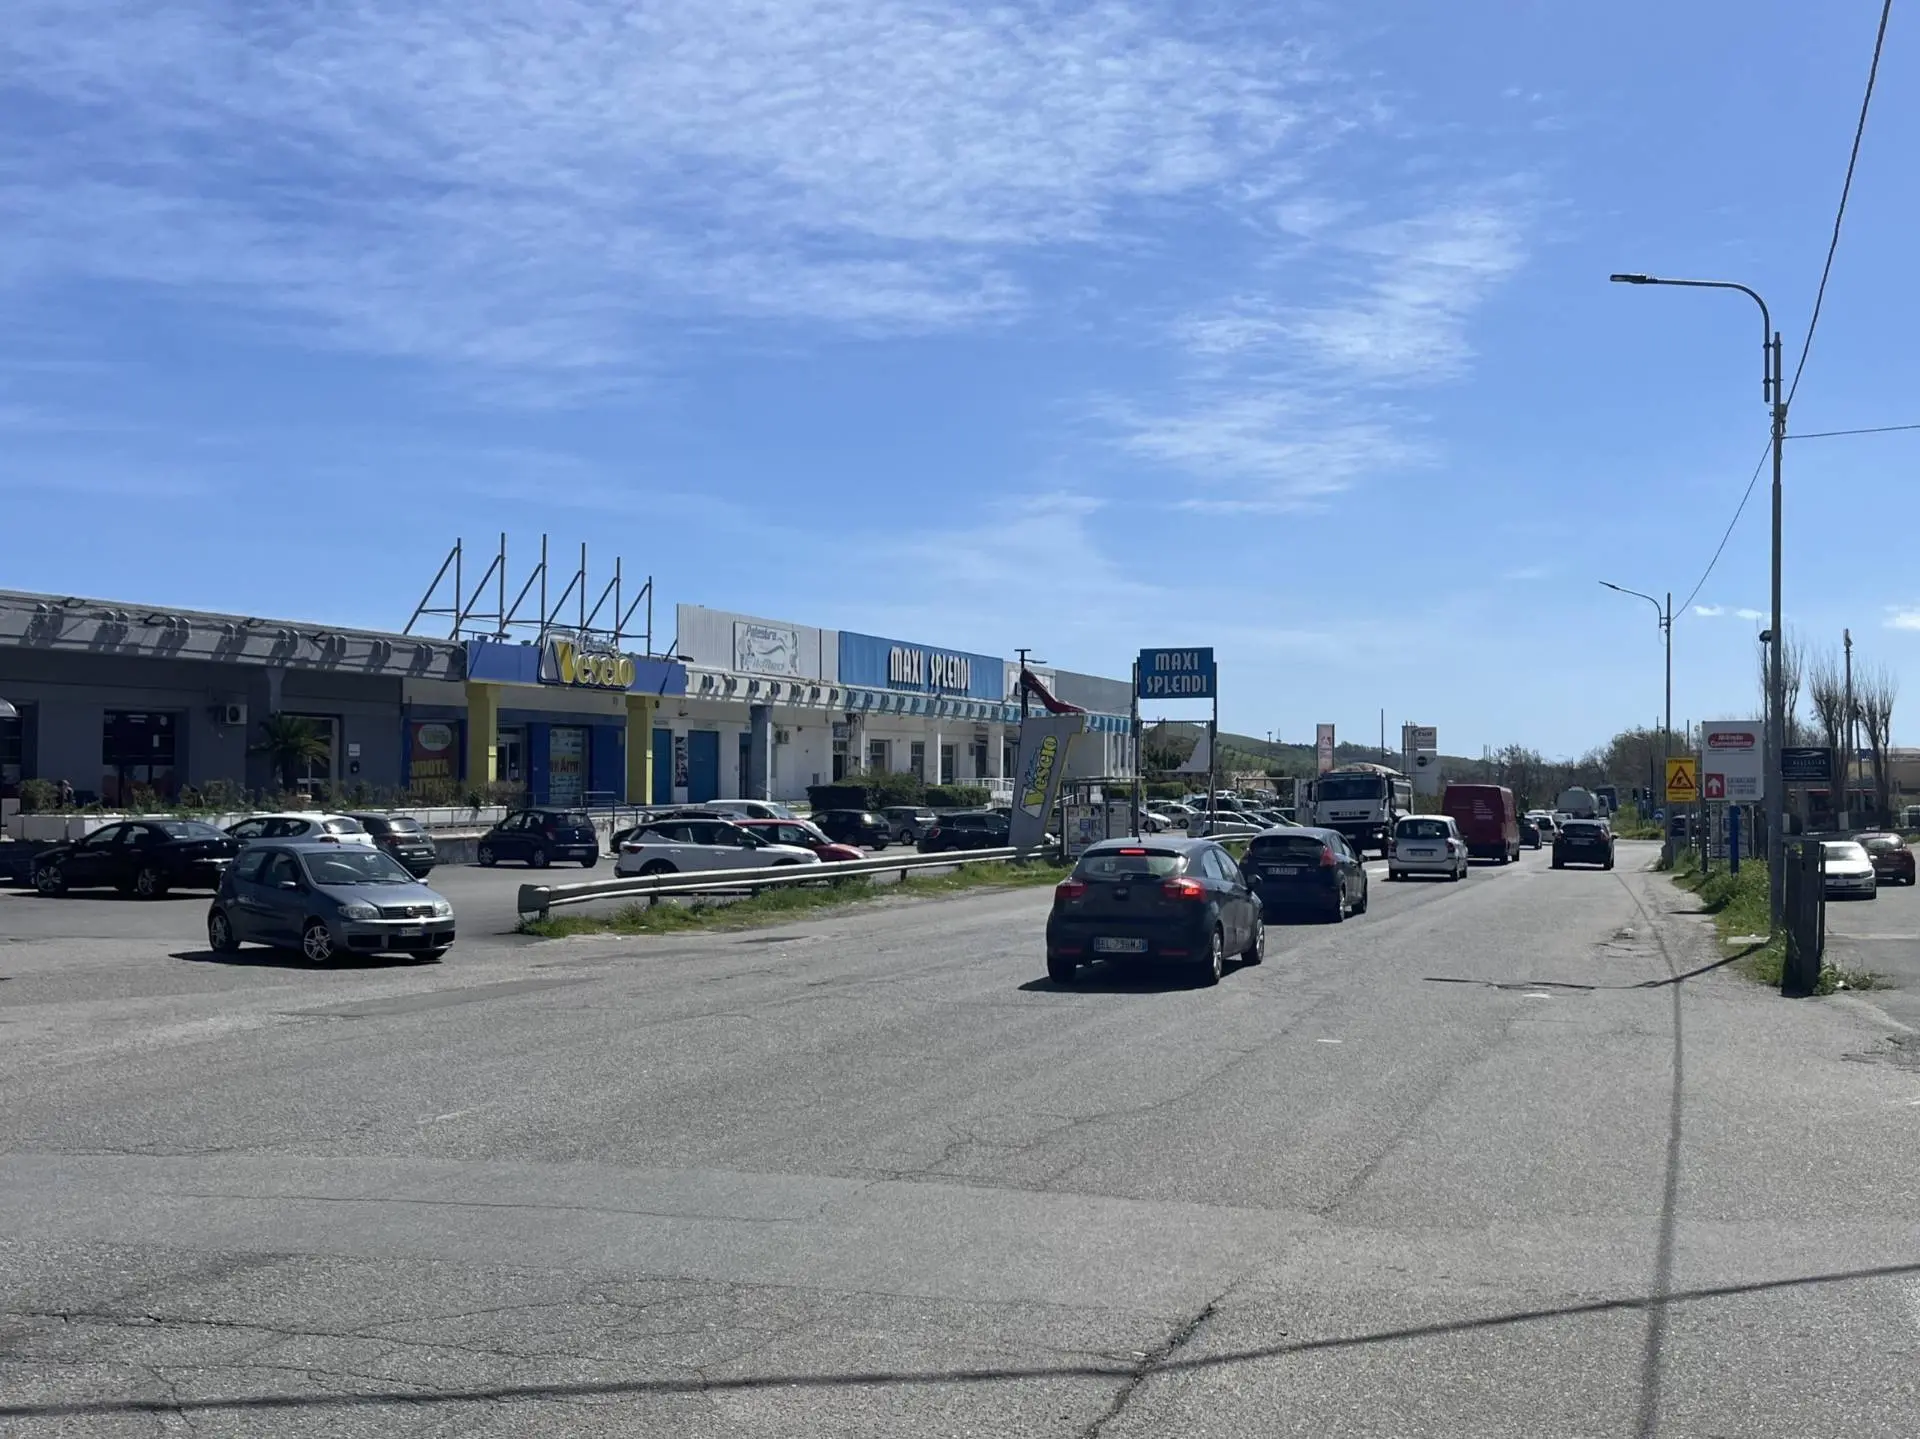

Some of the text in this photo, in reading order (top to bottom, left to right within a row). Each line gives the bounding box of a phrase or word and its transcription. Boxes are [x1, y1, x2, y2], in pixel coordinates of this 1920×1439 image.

[890, 646, 971, 691] MAXI SPLENDI
[1155, 652, 1199, 671] MAXI
[1147, 675, 1207, 694] SPLENDI
